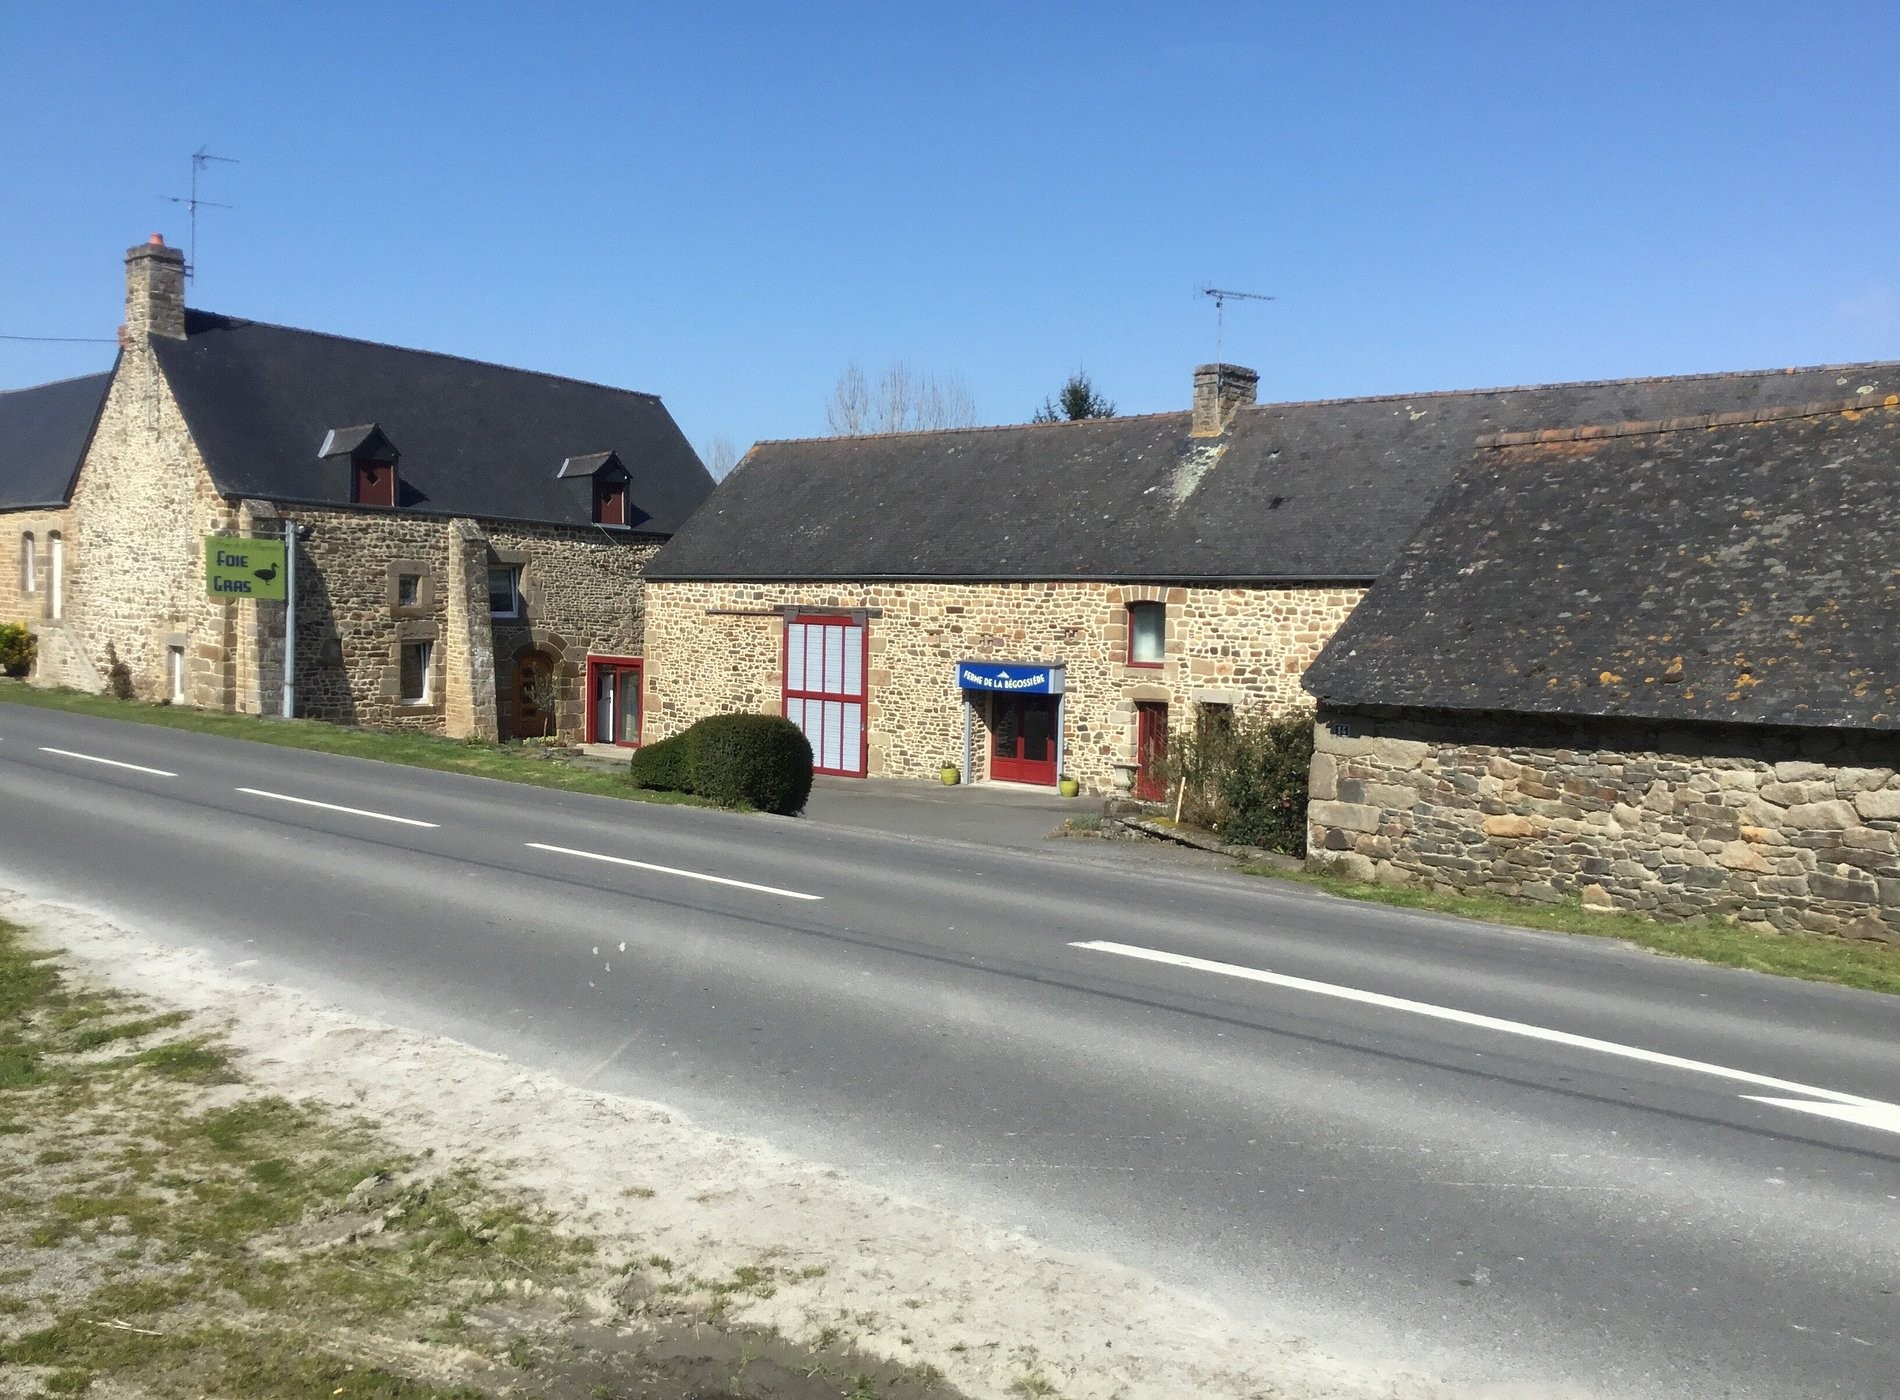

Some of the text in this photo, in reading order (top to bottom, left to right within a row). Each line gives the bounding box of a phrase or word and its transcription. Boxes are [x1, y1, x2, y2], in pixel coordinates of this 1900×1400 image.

[217, 550, 249, 568] FOIE
[213, 575, 252, 593] GRAS
[963, 670, 983, 685] FERME
[983, 678, 993, 687] DE
[993, 680, 1003, 688] LA
